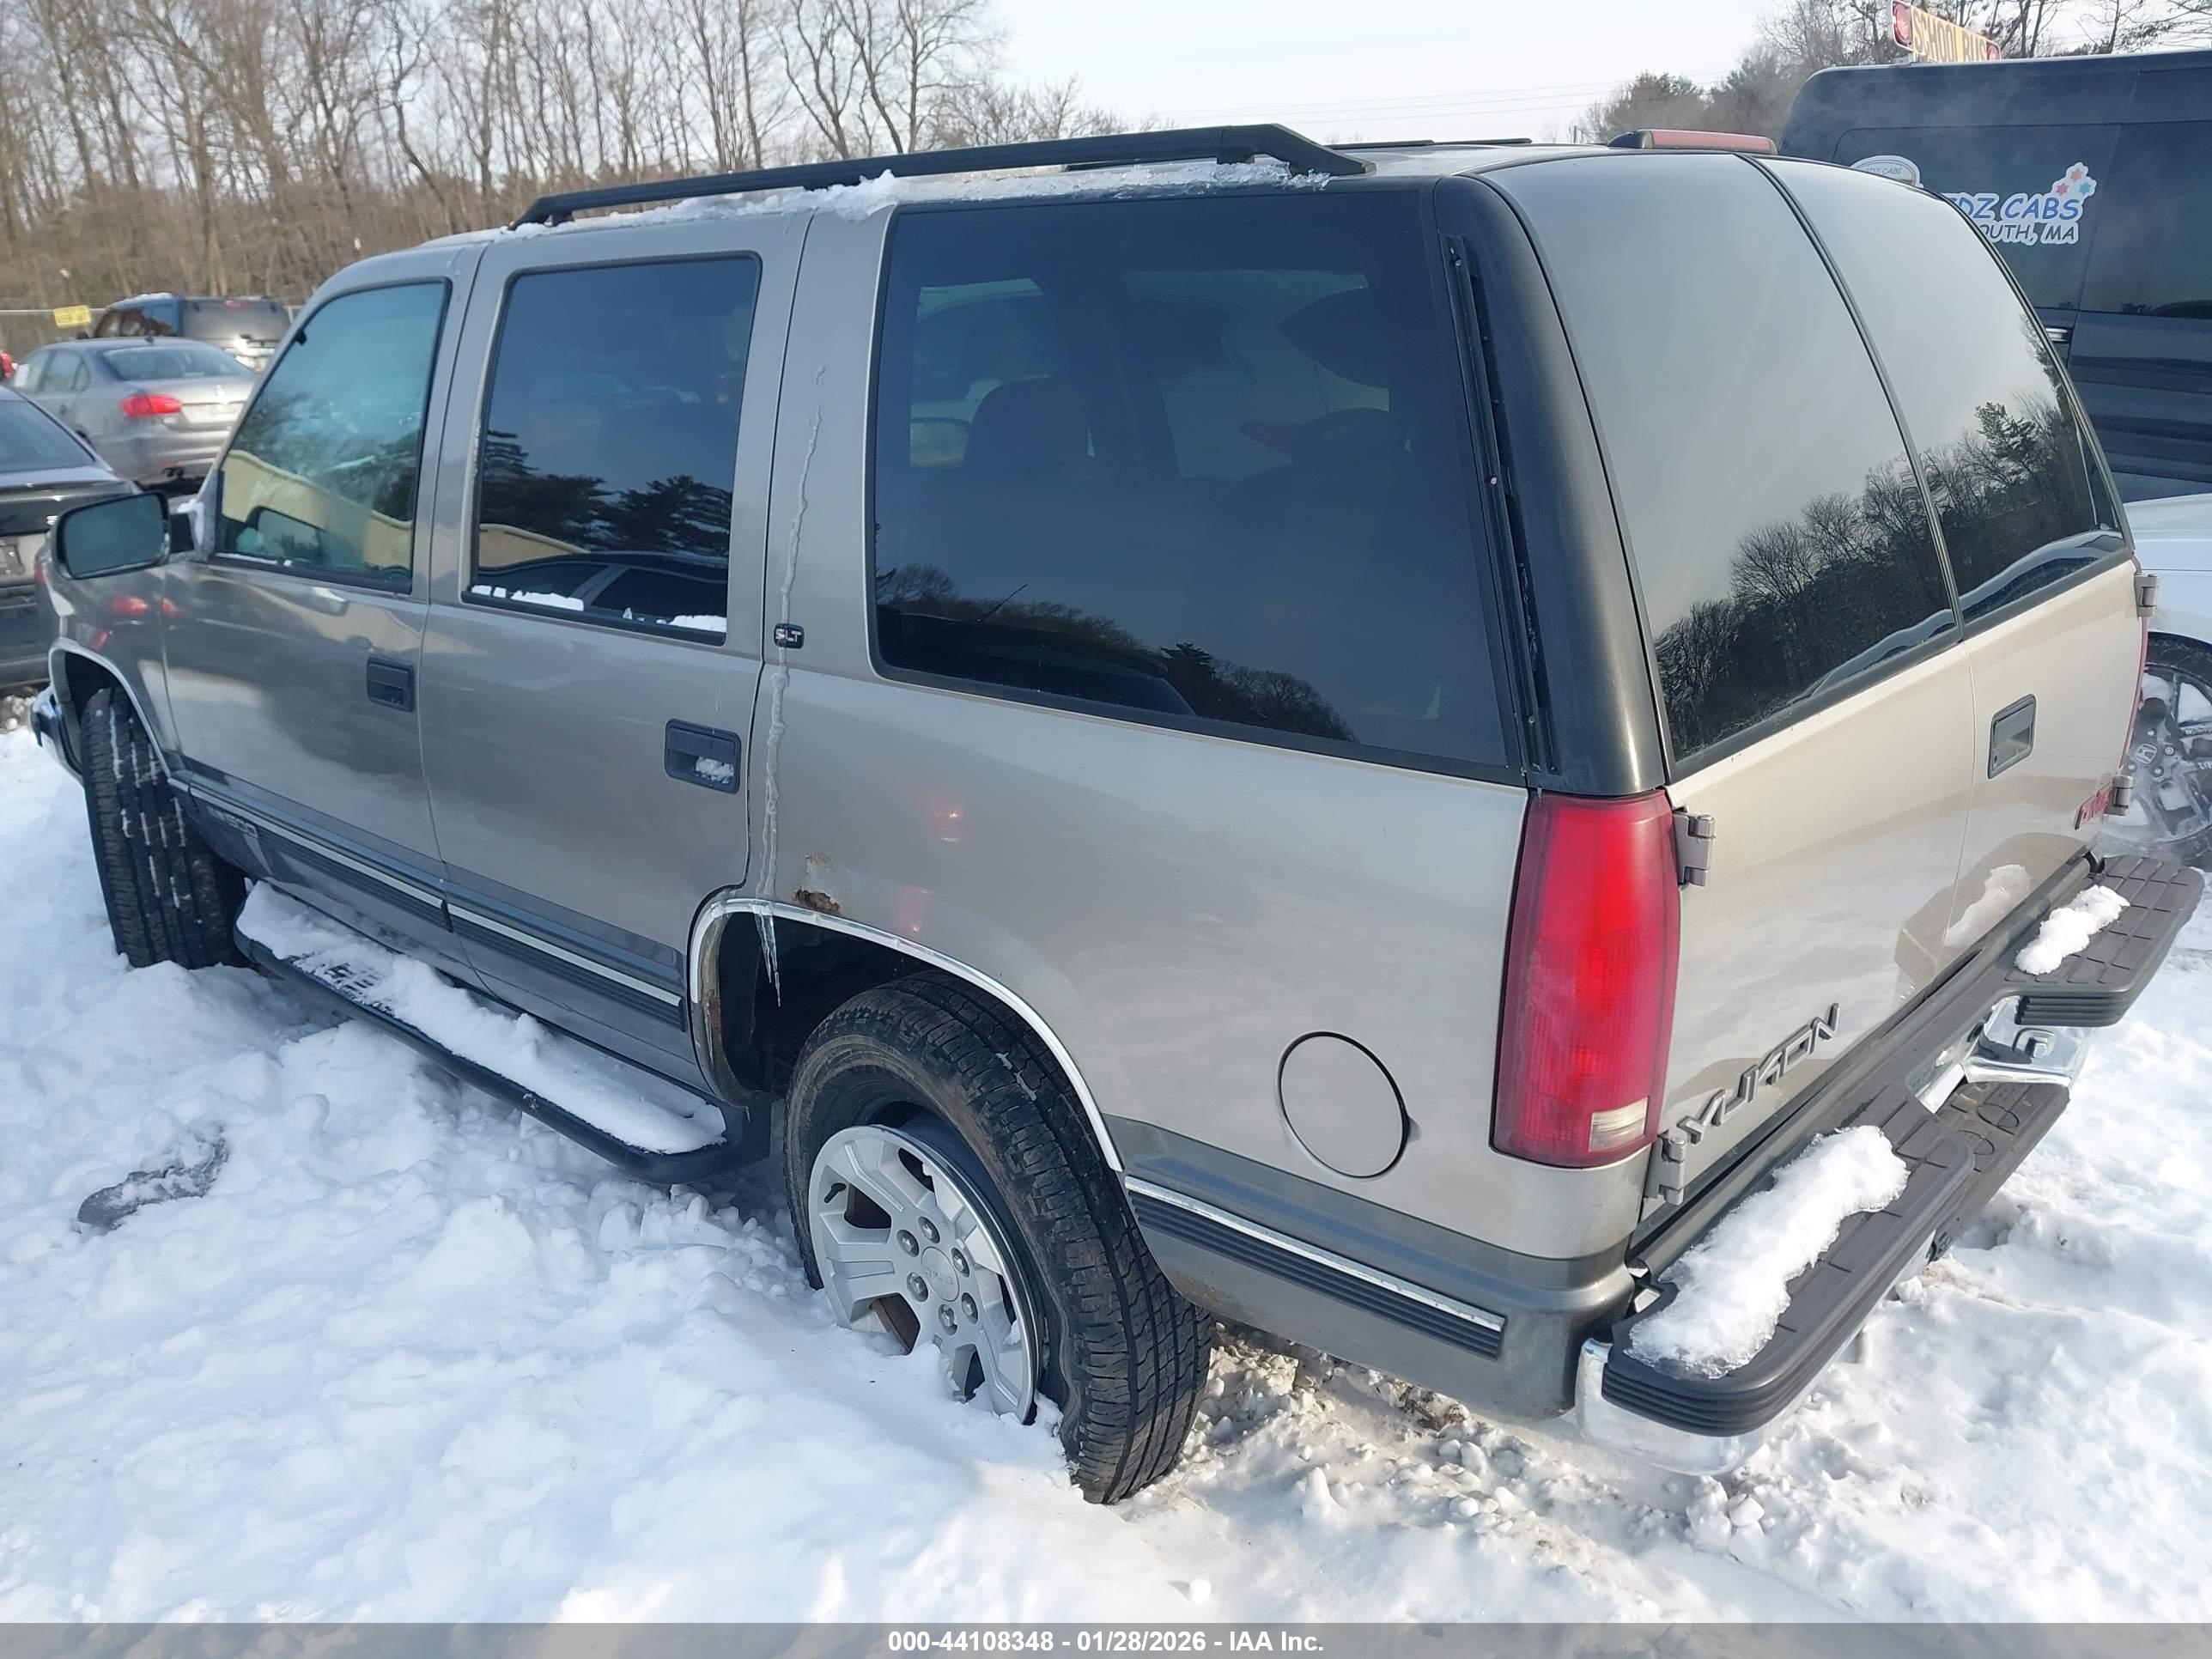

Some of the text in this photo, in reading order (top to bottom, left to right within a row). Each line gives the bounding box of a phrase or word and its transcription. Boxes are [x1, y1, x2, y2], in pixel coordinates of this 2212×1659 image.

[1950, 197, 2080, 221] DZ CABS
[2045, 225, 2075, 240] MA
[775, 629, 802, 642] SLT
[1676, 1002, 1841, 1145] YUKON
